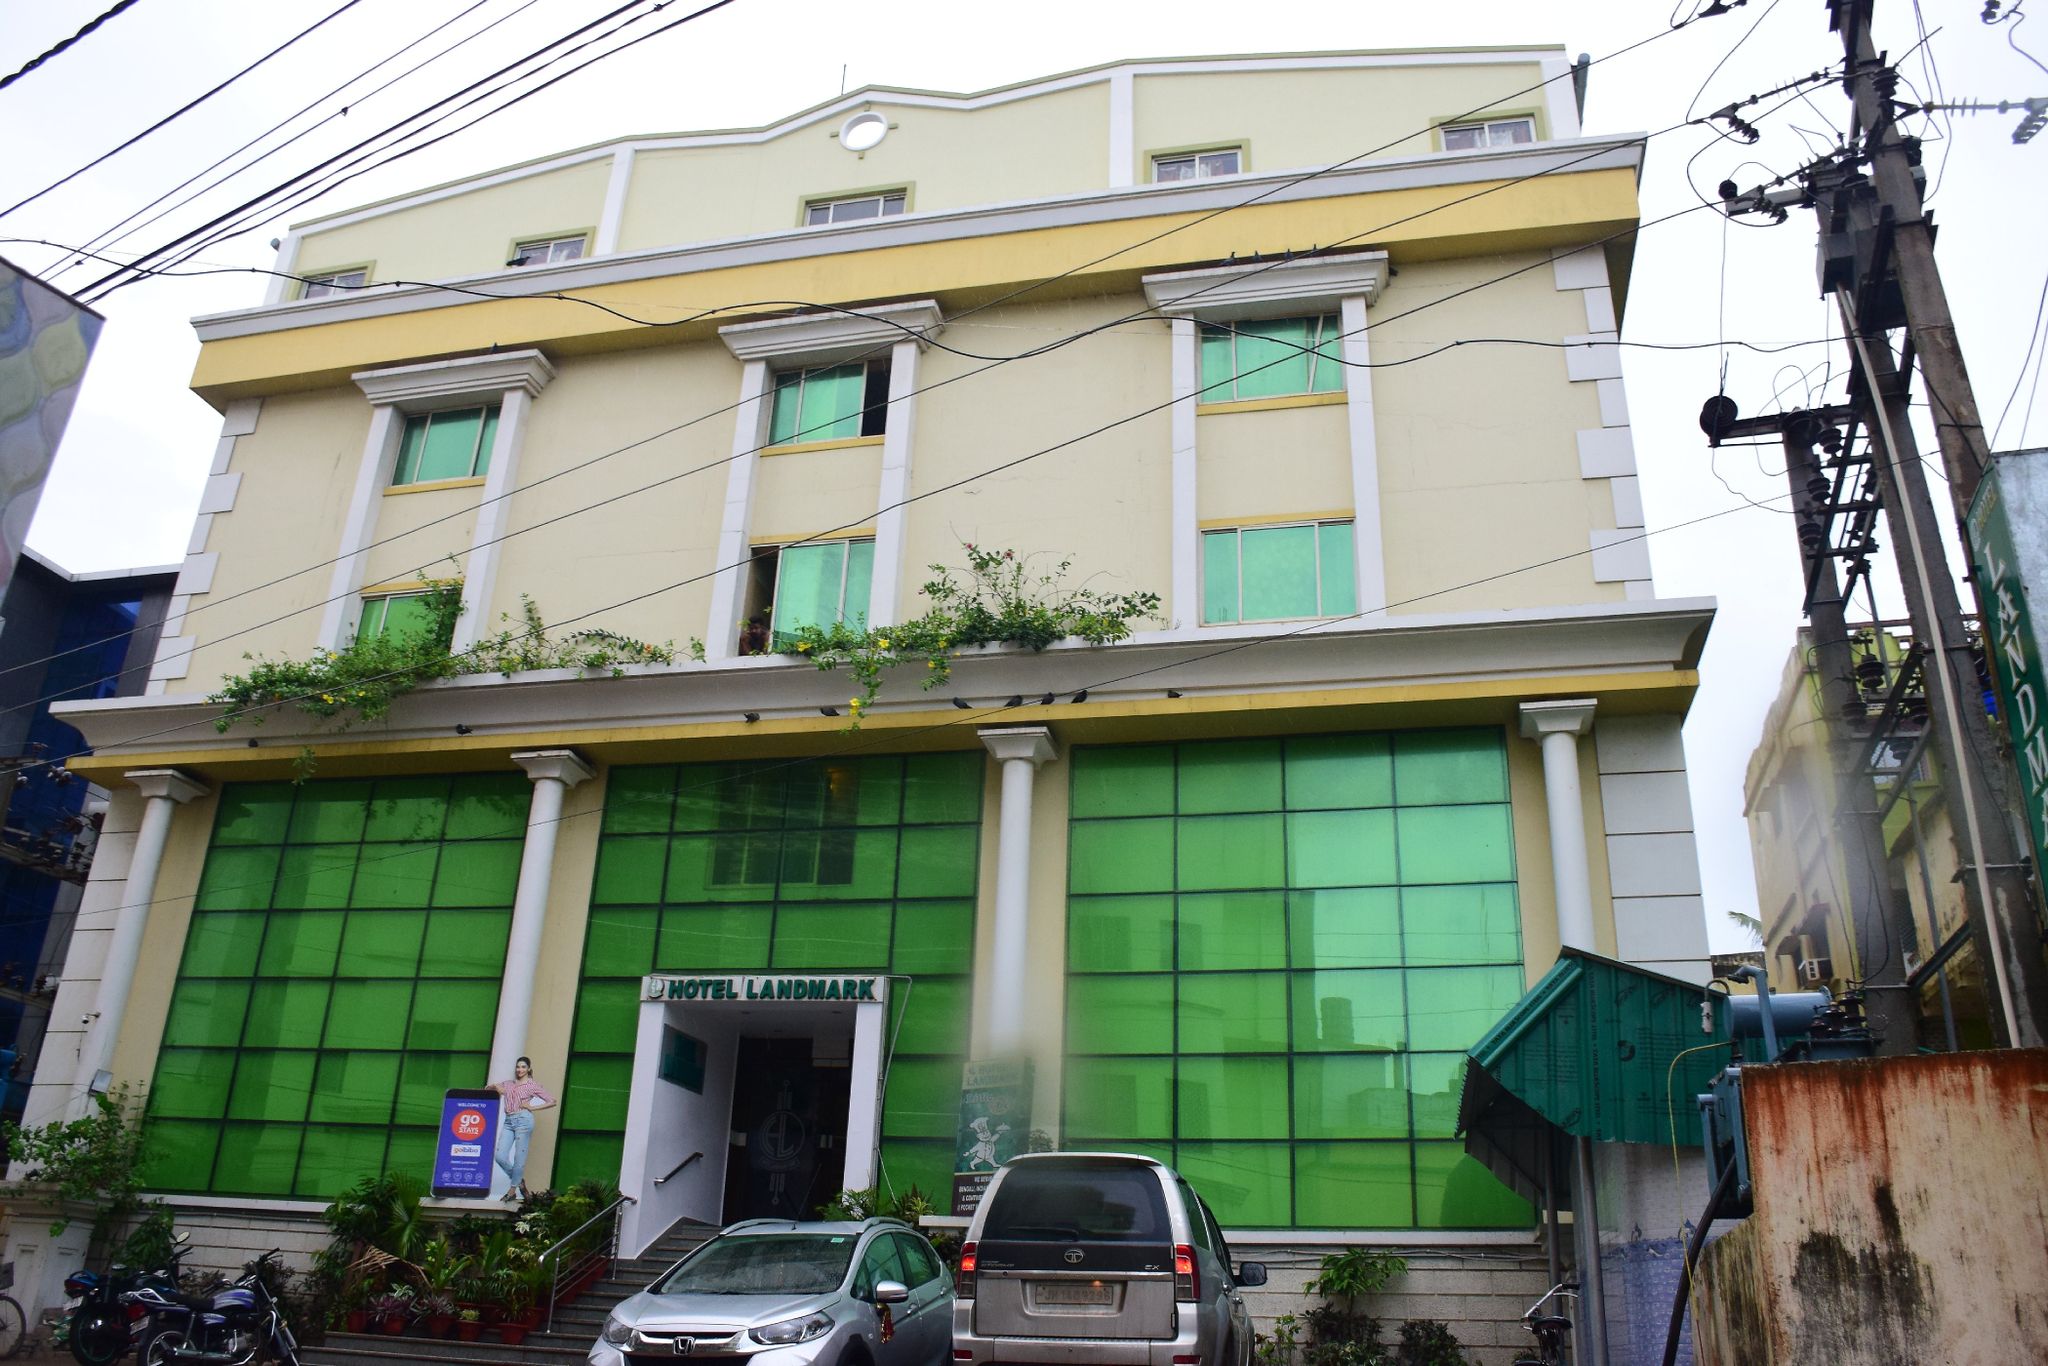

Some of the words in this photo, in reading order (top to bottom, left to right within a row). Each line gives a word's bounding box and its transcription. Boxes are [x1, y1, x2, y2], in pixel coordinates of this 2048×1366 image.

[668, 979, 739, 999] HOTEL
[746, 979, 877, 1000] LANDMARK
[460, 1114, 480, 1127] go
[458, 1126, 479, 1135] STAYS
